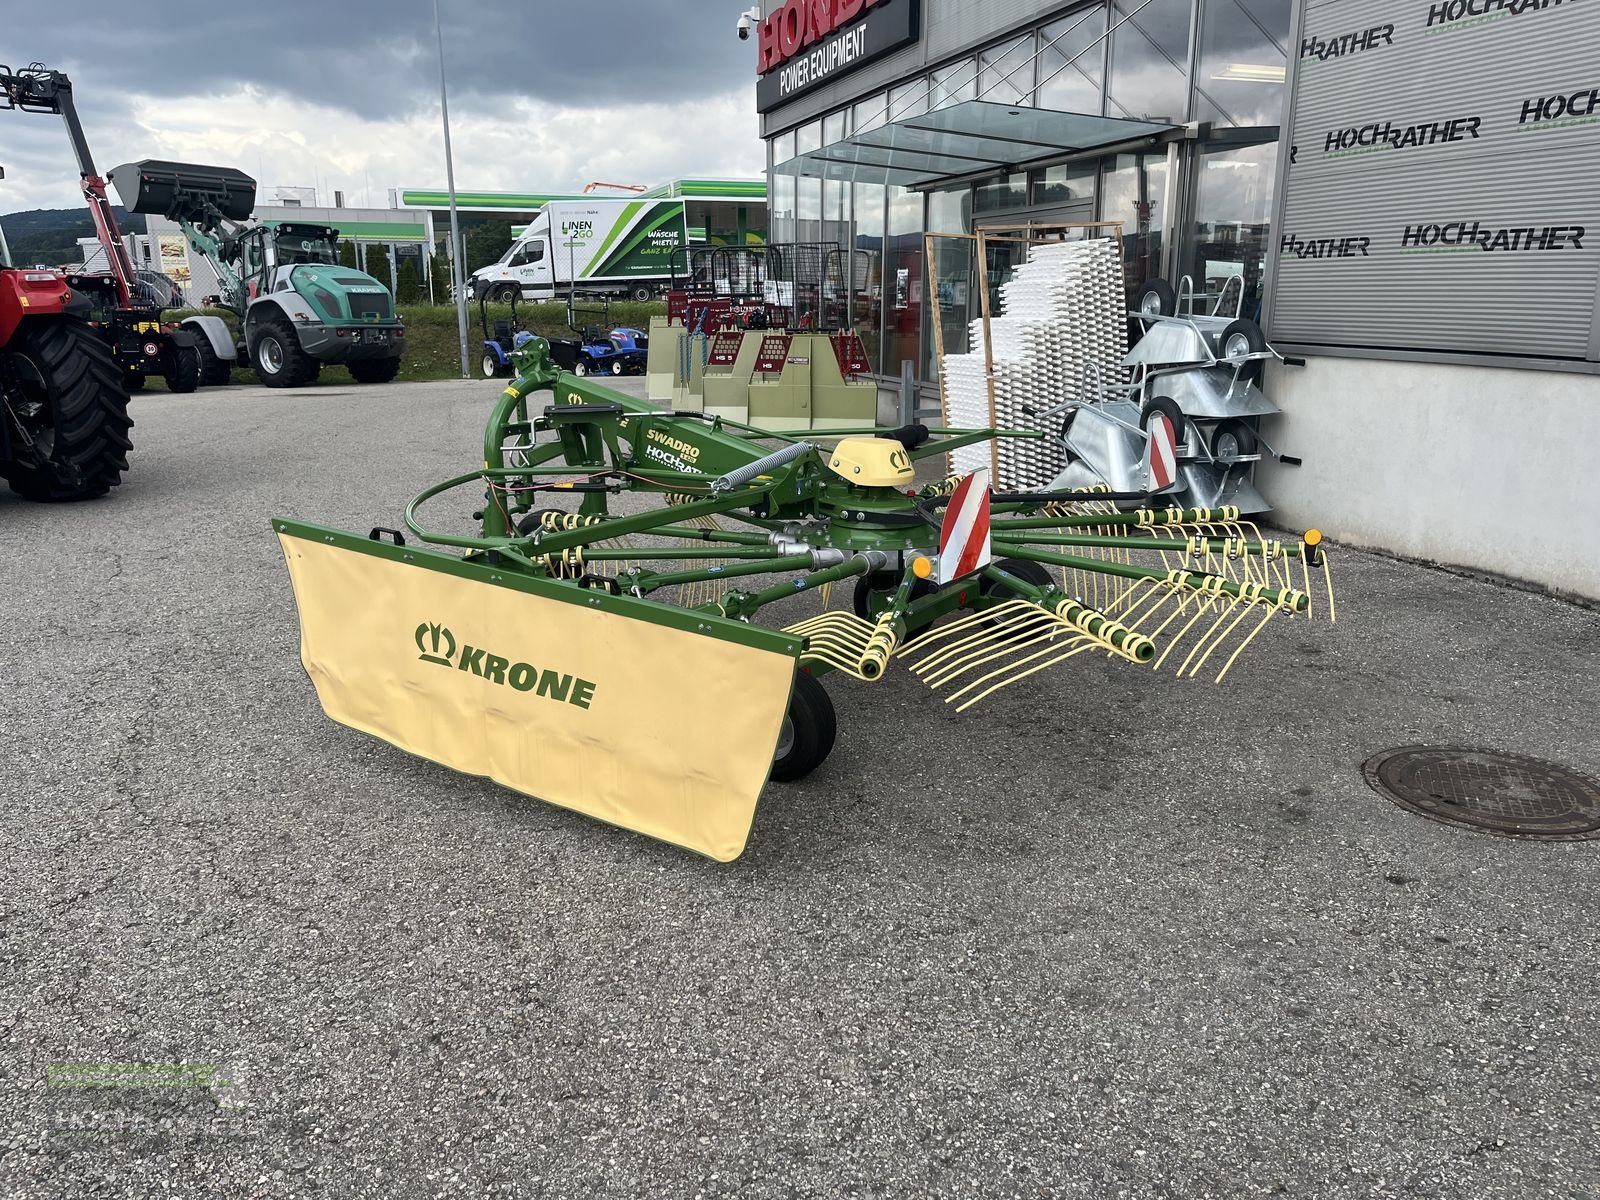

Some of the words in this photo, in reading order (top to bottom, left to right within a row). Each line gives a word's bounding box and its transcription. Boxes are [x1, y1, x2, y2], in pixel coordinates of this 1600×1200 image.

[780, 57, 809, 96] POWER
[810, 24, 867, 78] EQUIPMENT
[1324, 116, 1481, 151] HOCHRATHER
[562, 221, 592, 230] LINEN
[573, 230, 593, 238] 2GO
[648, 230, 679, 238] WÄSCHE
[1401, 222, 1585, 251] HOCHRATHER
[646, 429, 700, 458] SWADRO
[646, 445, 708, 474] HOCHRAT
[458, 645, 597, 710] KRONE
